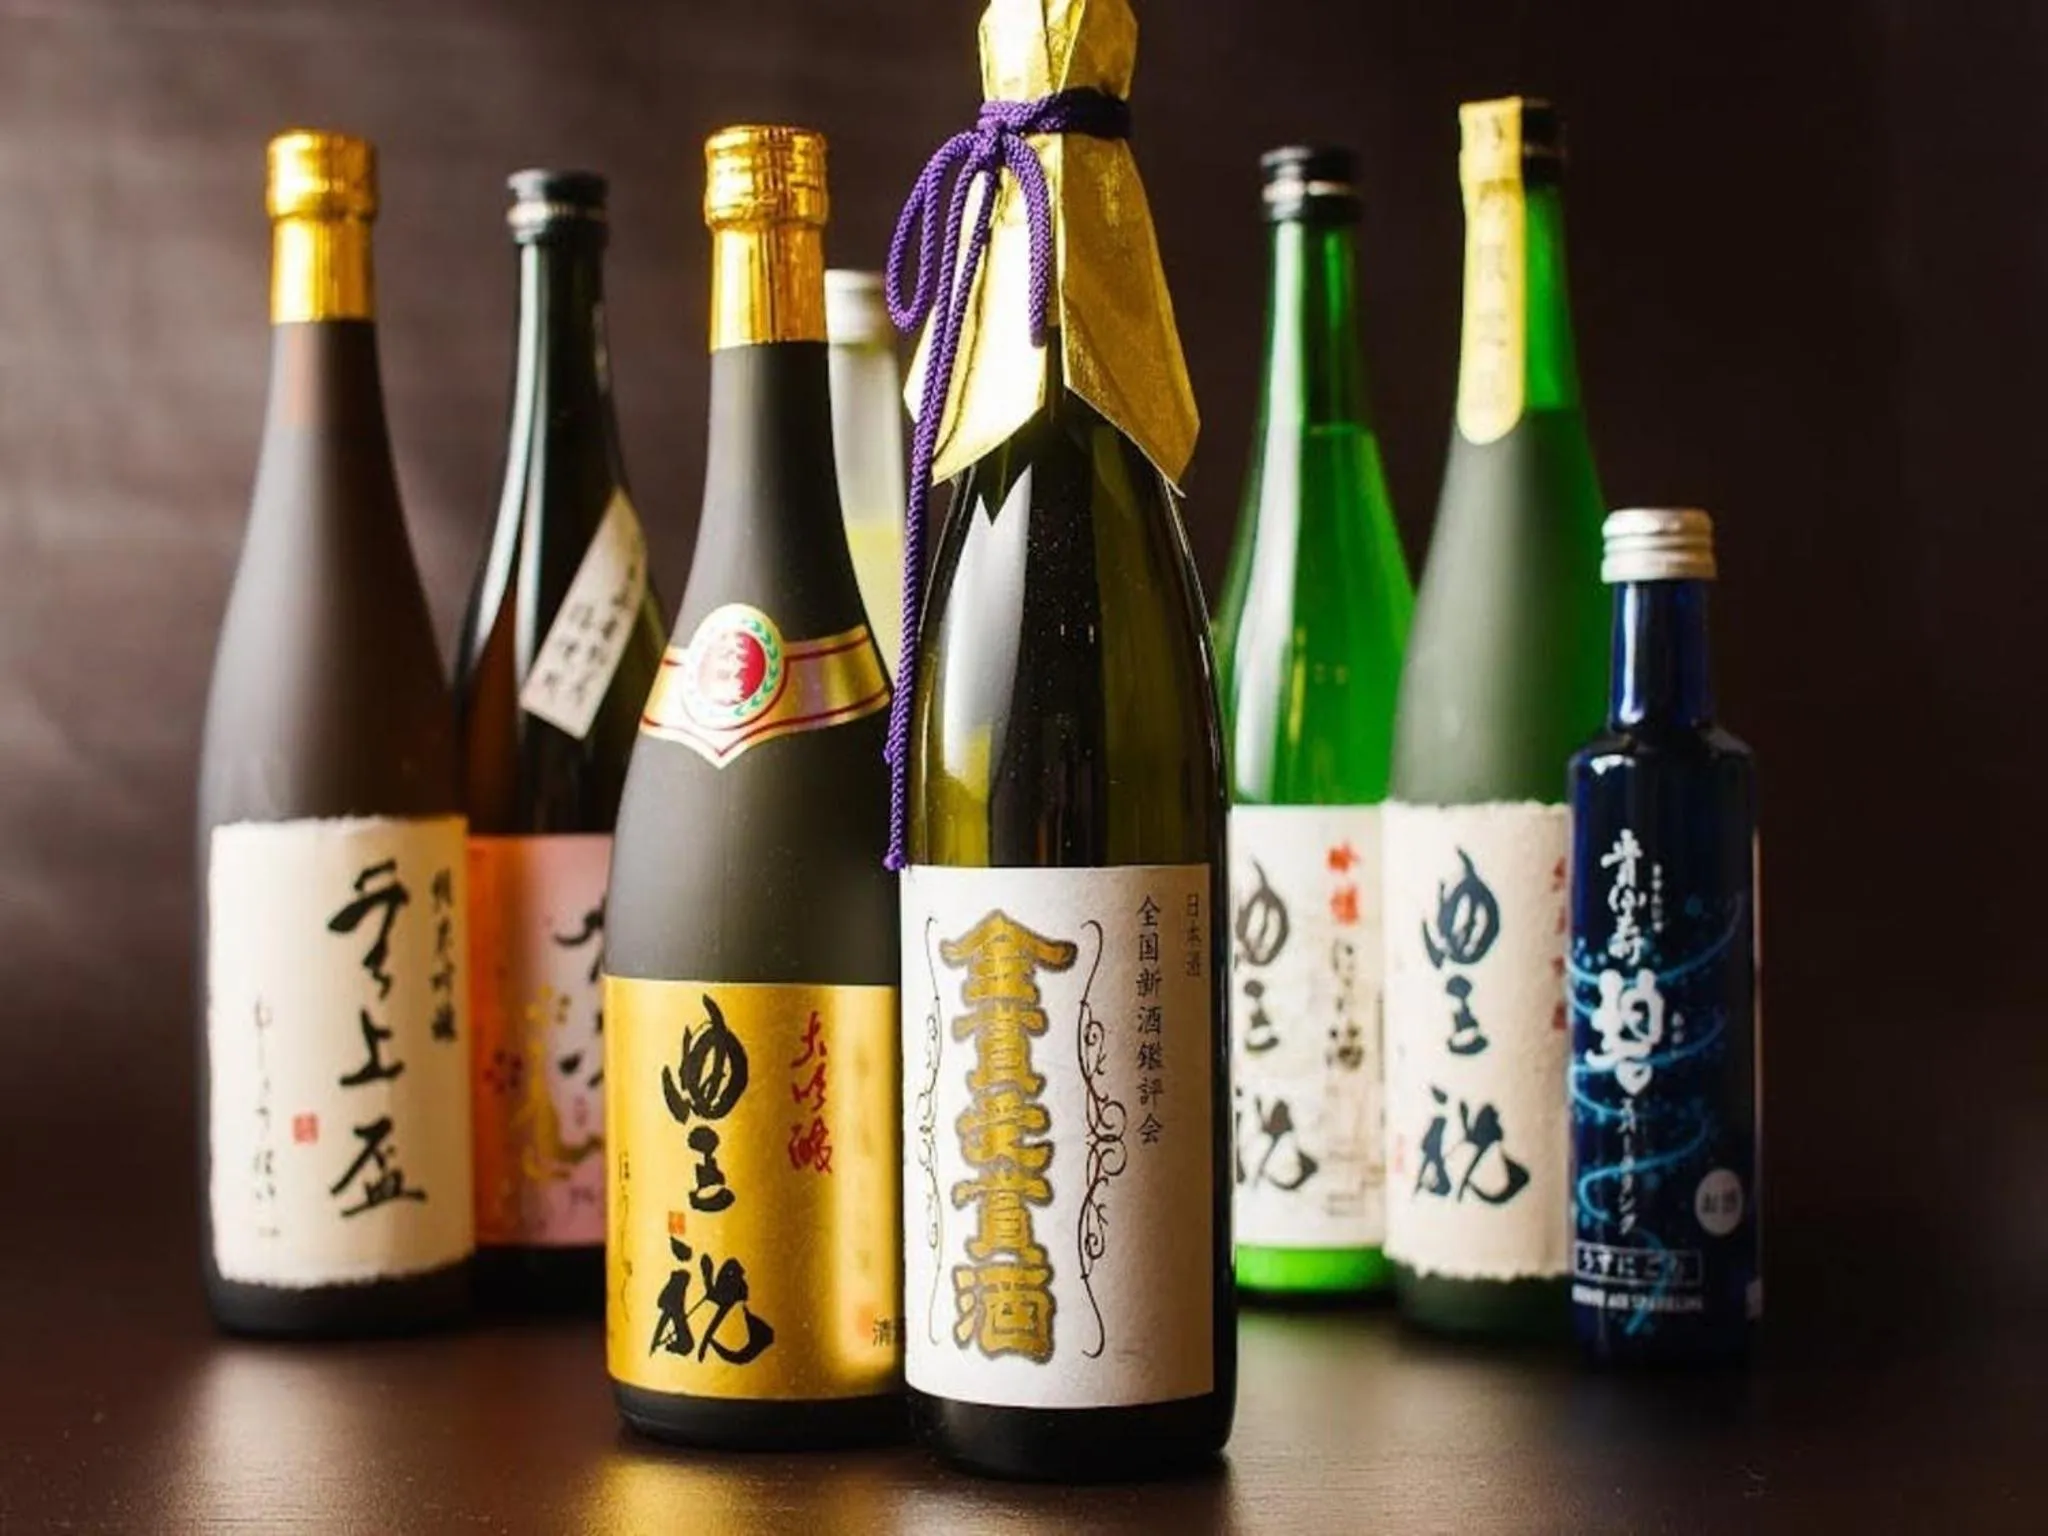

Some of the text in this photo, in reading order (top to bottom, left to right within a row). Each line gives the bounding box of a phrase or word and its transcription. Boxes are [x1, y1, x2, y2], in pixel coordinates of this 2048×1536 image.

[1135, 894, 1164, 1146] 全国新酒鑑評会
[1186, 893, 1202, 977] 日本酒
[939, 908, 1078, 1365] 金賞受賞酒
